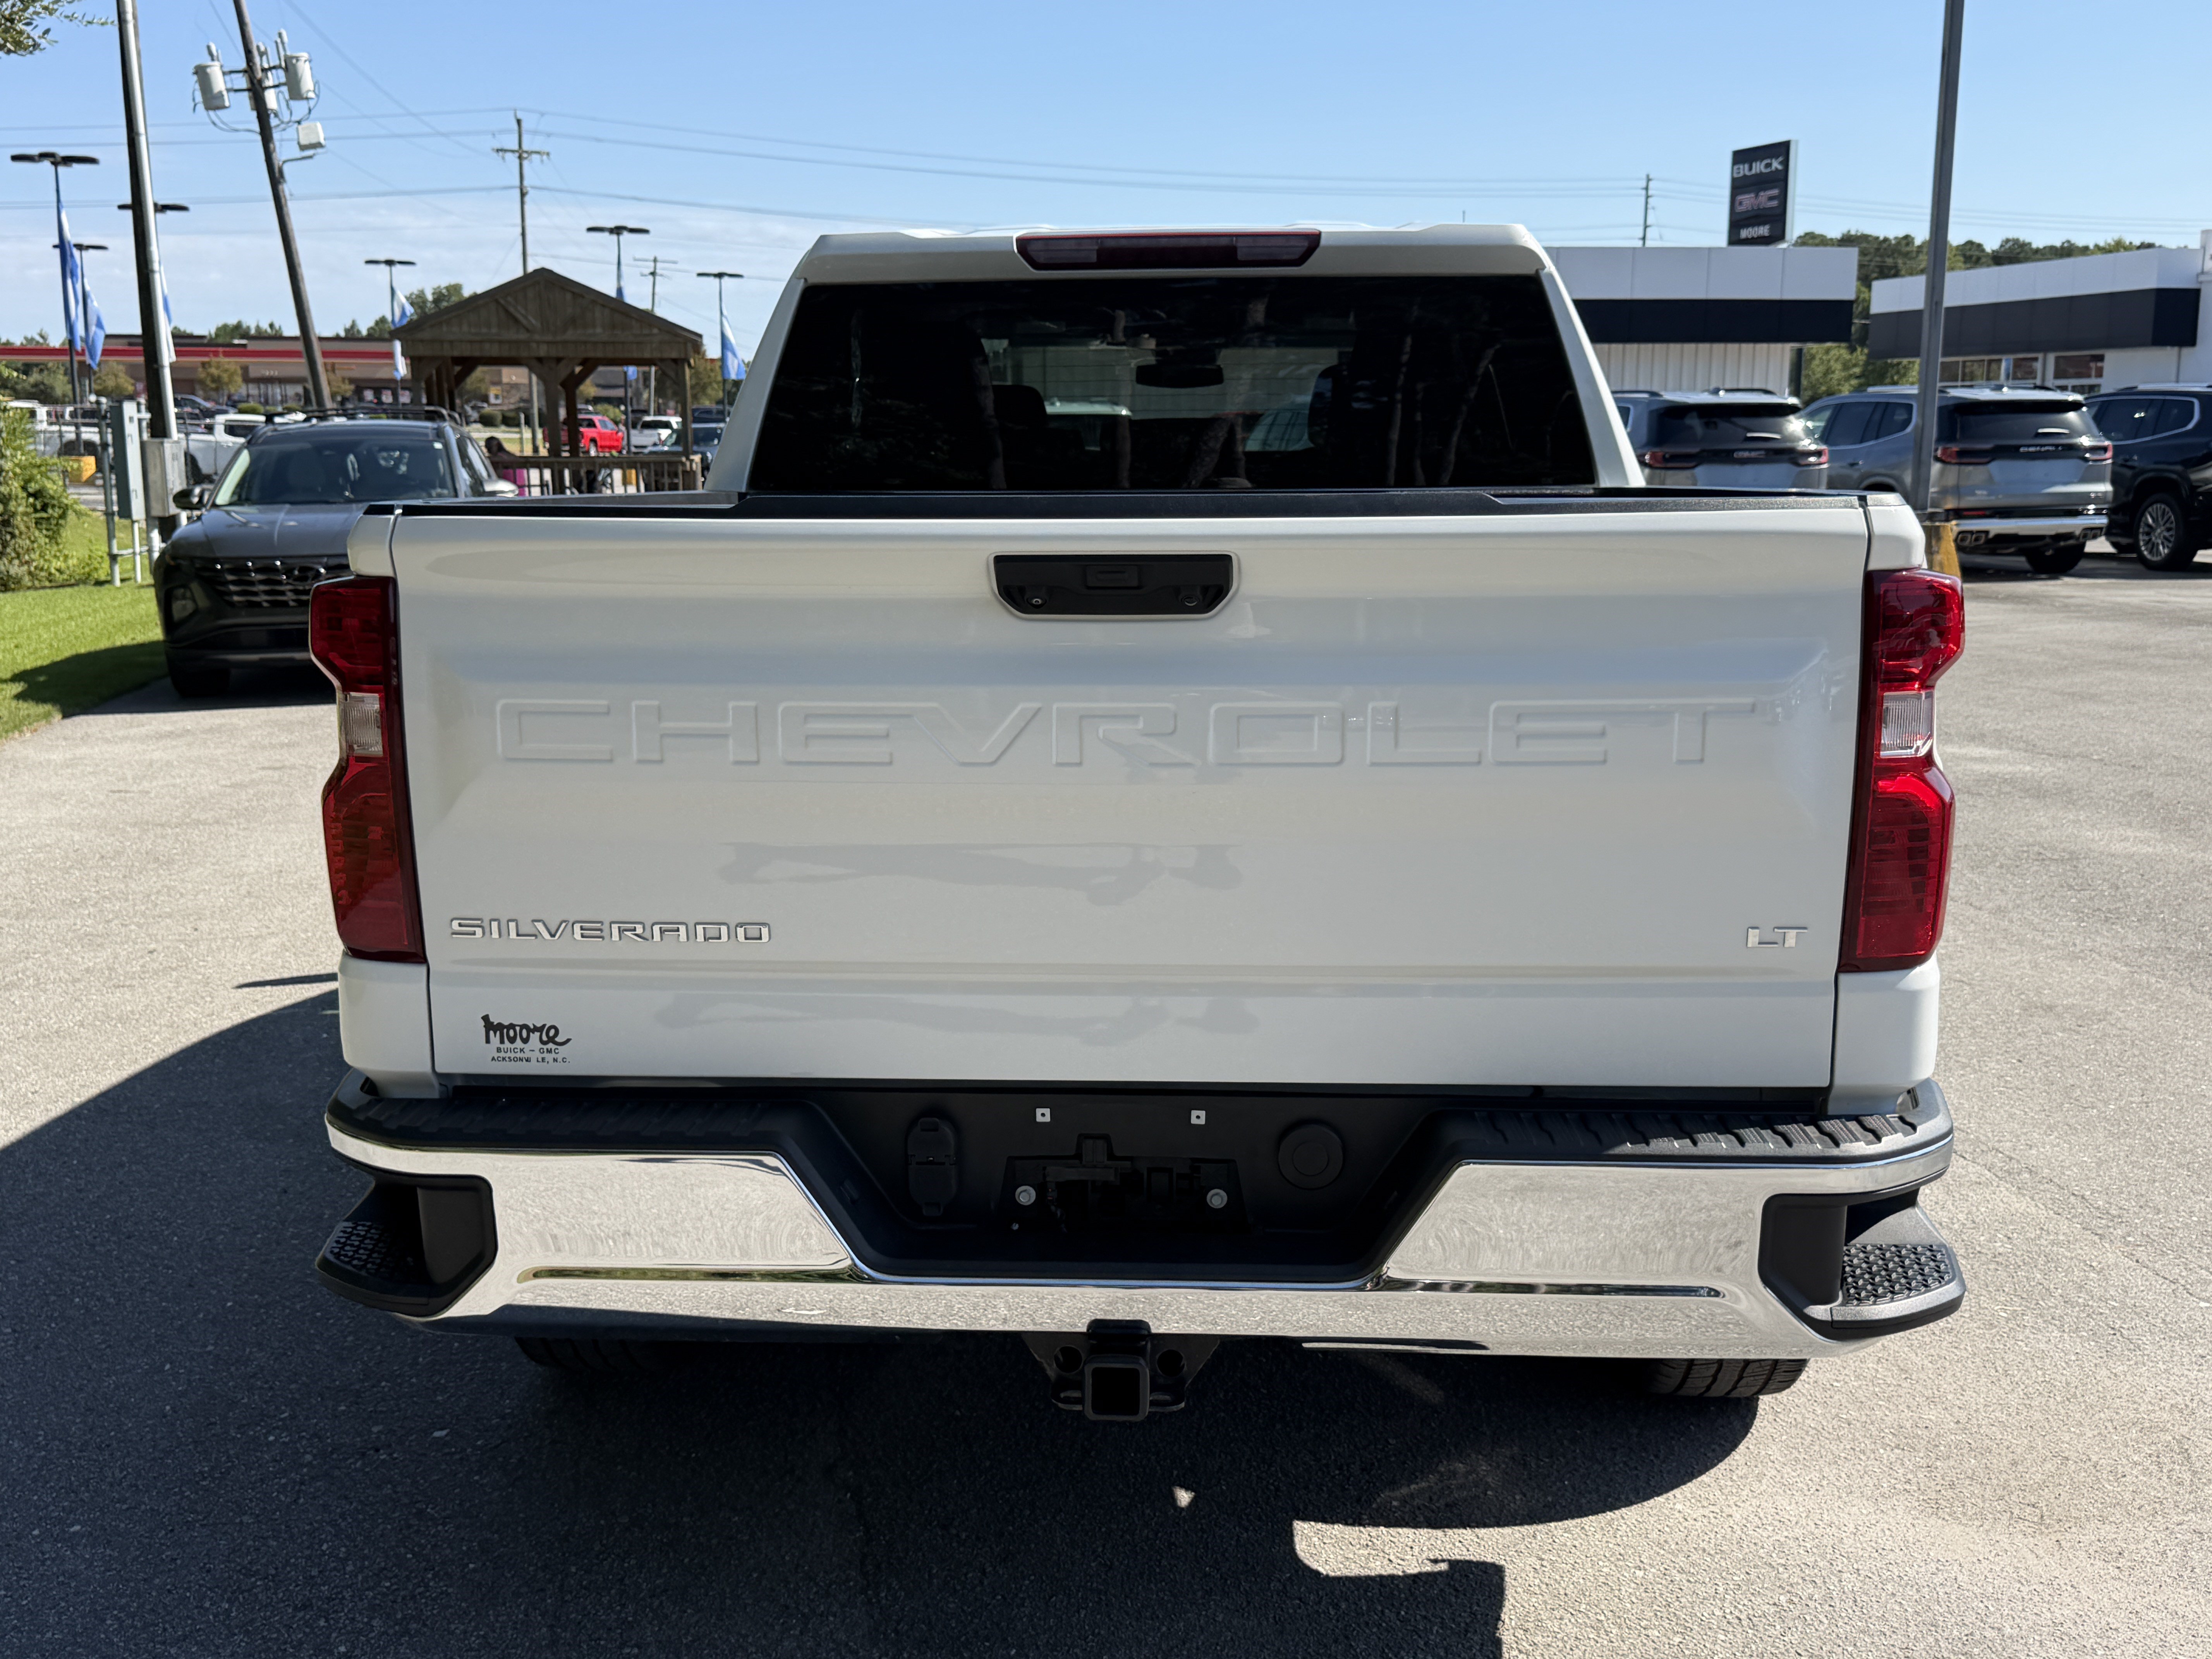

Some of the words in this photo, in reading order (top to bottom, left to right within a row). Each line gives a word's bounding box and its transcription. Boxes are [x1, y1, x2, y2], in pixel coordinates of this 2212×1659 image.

[1733, 156, 1784, 178] BUICK
[1735, 188, 1780, 213] GMC
[496, 697, 1756, 766] CHEVROLET
[451, 918, 771, 943] SILVERADO
[1747, 927, 1808, 947] LT
